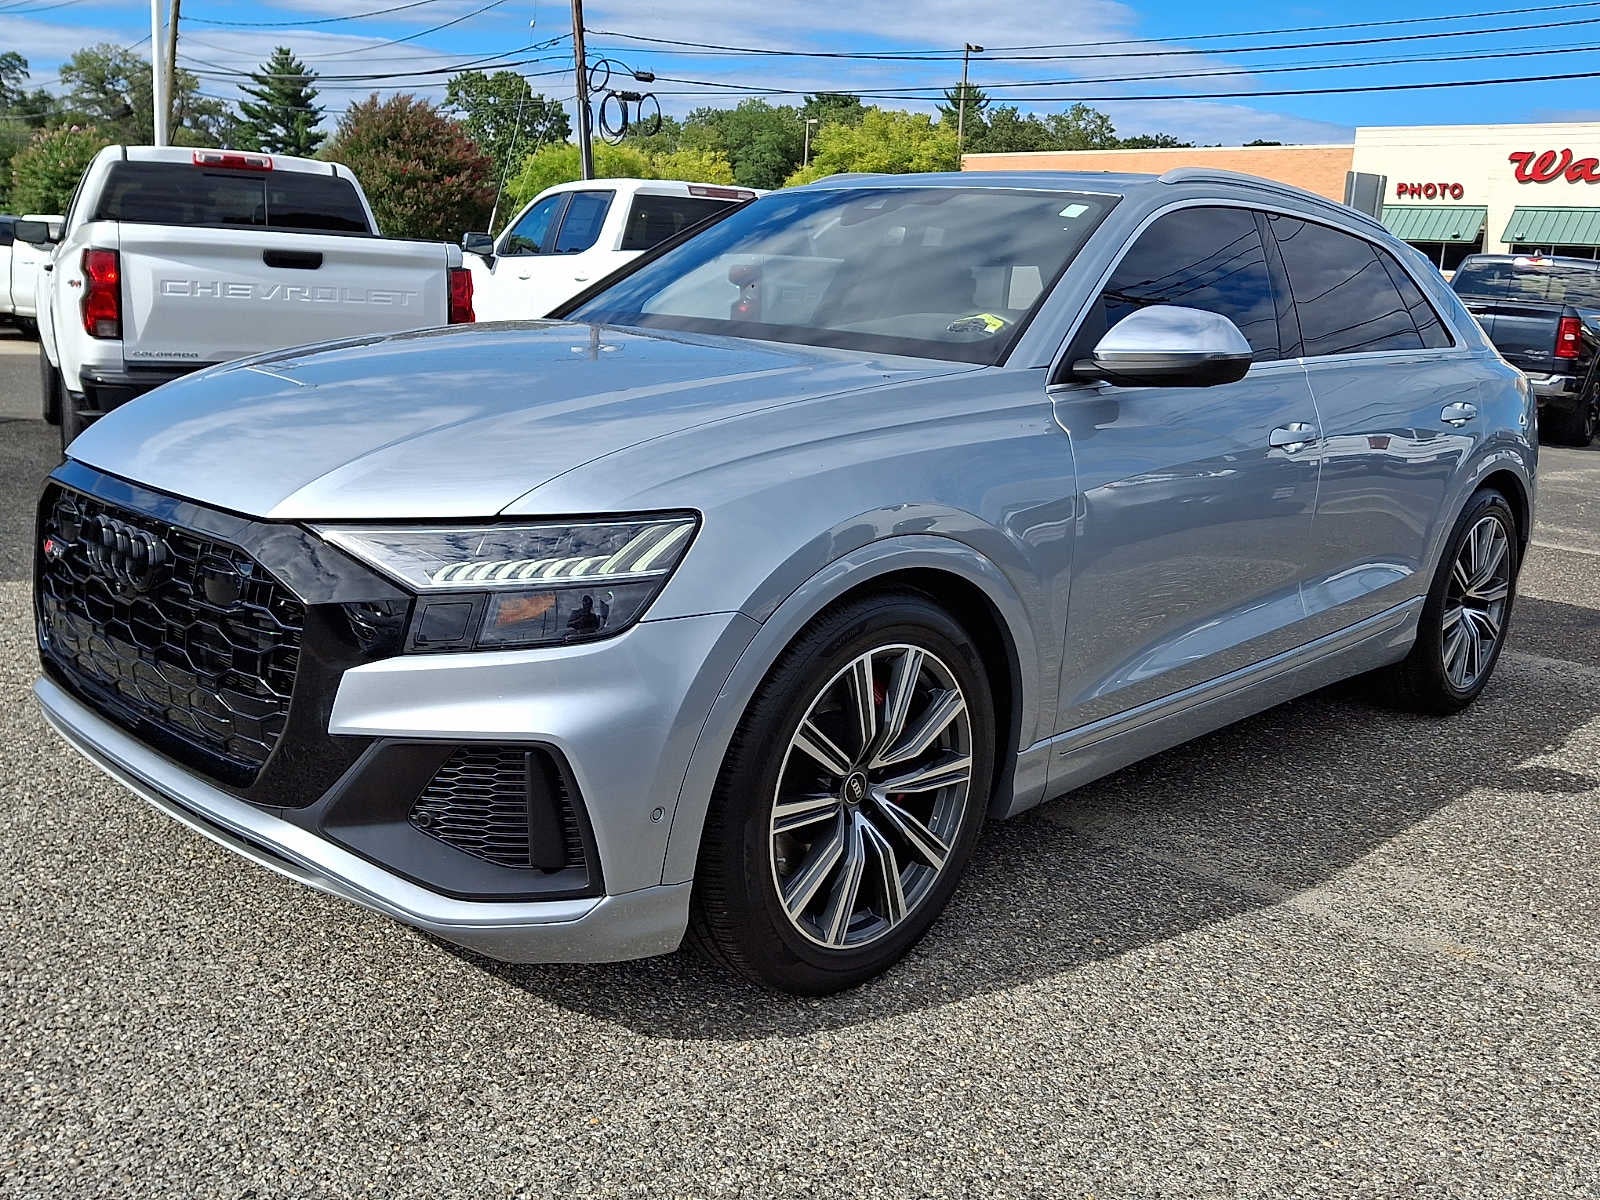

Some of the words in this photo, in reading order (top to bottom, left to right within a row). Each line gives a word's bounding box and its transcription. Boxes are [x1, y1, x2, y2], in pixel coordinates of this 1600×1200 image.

[1508, 148, 1600, 184] Wa
[1396, 183, 1464, 200] PHOTO
[160, 279, 418, 306] CHEVROLET
